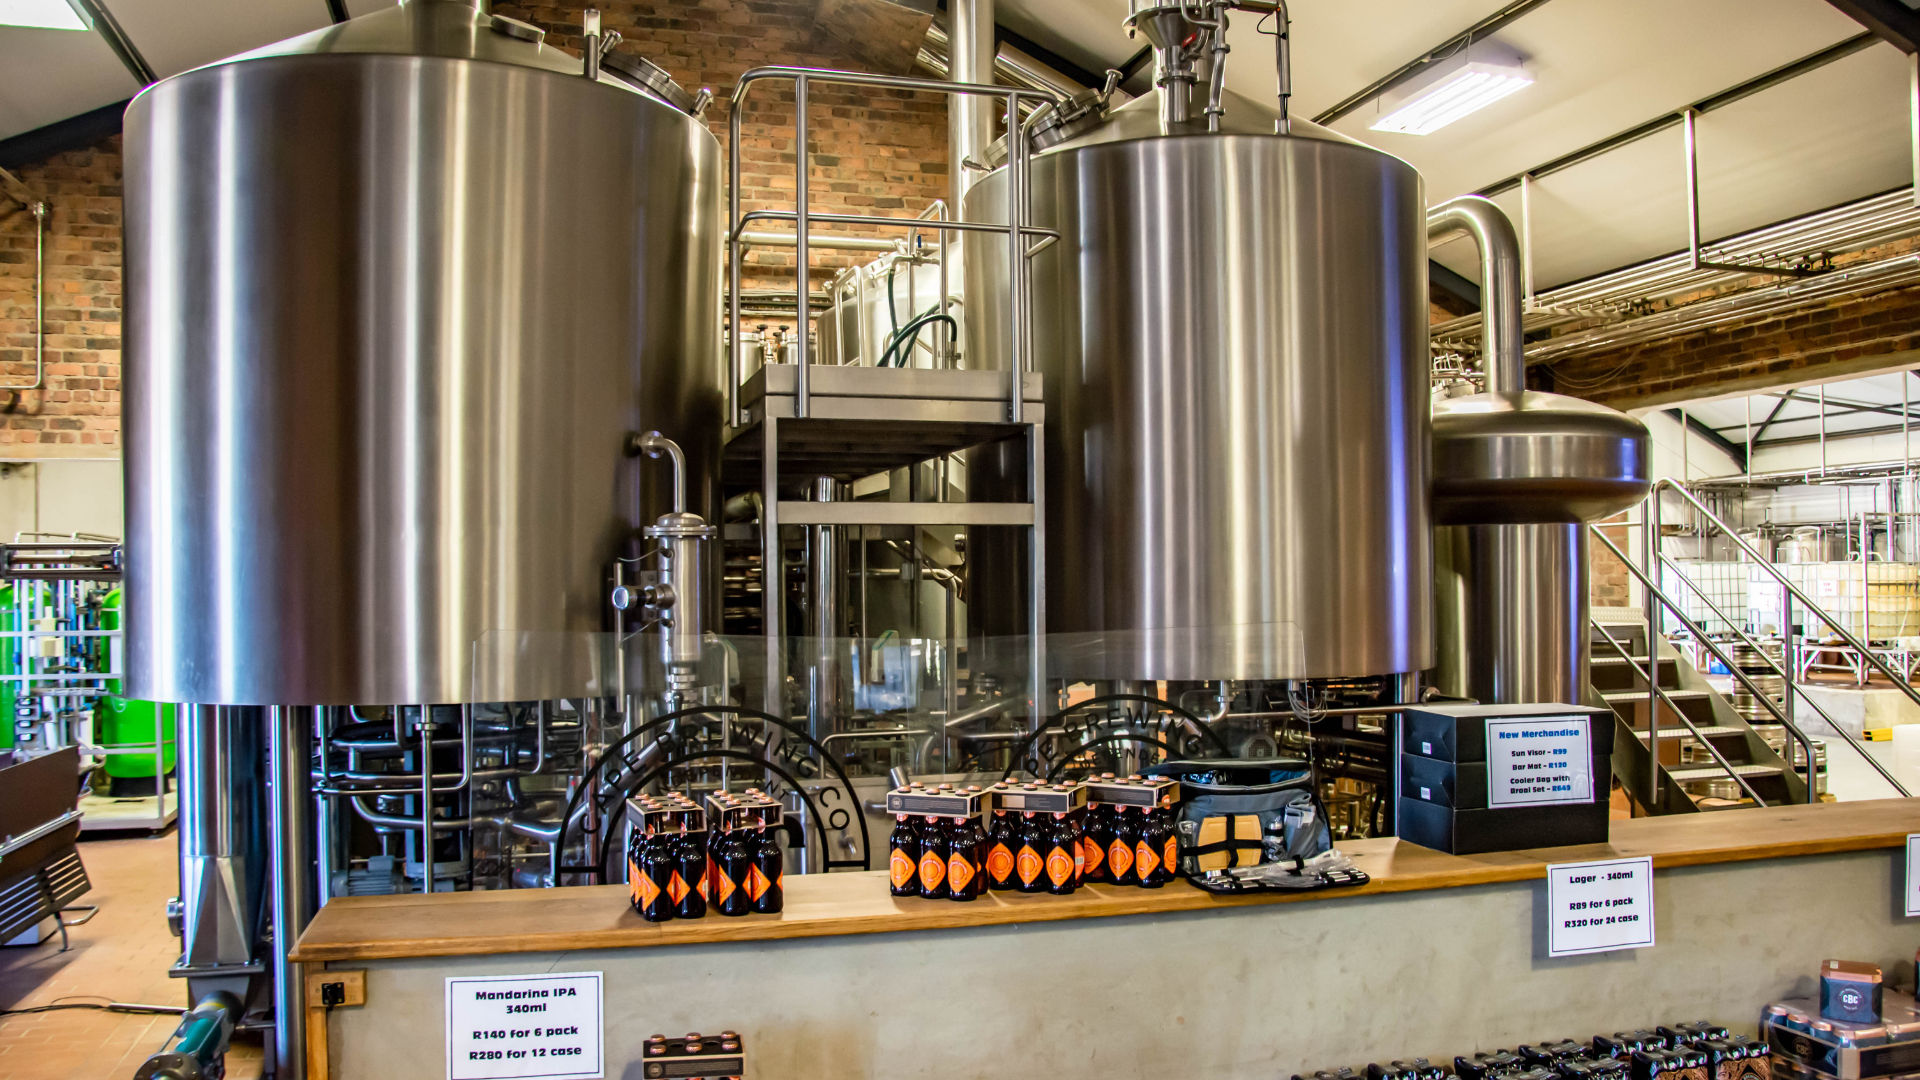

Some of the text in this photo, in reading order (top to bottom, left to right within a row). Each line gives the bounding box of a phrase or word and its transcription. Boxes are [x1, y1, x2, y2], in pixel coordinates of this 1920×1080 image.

[1063, 707, 1202, 755] BREWING
[1499, 729, 1580, 739] New Merchandise
[580, 720, 850, 834] CAPE BREWING CO
[1569, 875, 1596, 884] Lager
[1607, 871, 1633, 880] 340ml
[1569, 902, 1587, 910] R89
[1612, 897, 1633, 907] pack
[1564, 914, 1639, 928] R320 for 24 case
[475, 987, 577, 1000] Mandarina IPA
[1842, 994, 1859, 1004] CBC
[506, 1003, 547, 1014] 340ml
[472, 1026, 579, 1040] R140 for 6 pack
[469, 1047, 582, 1060] R280 for 12 case
